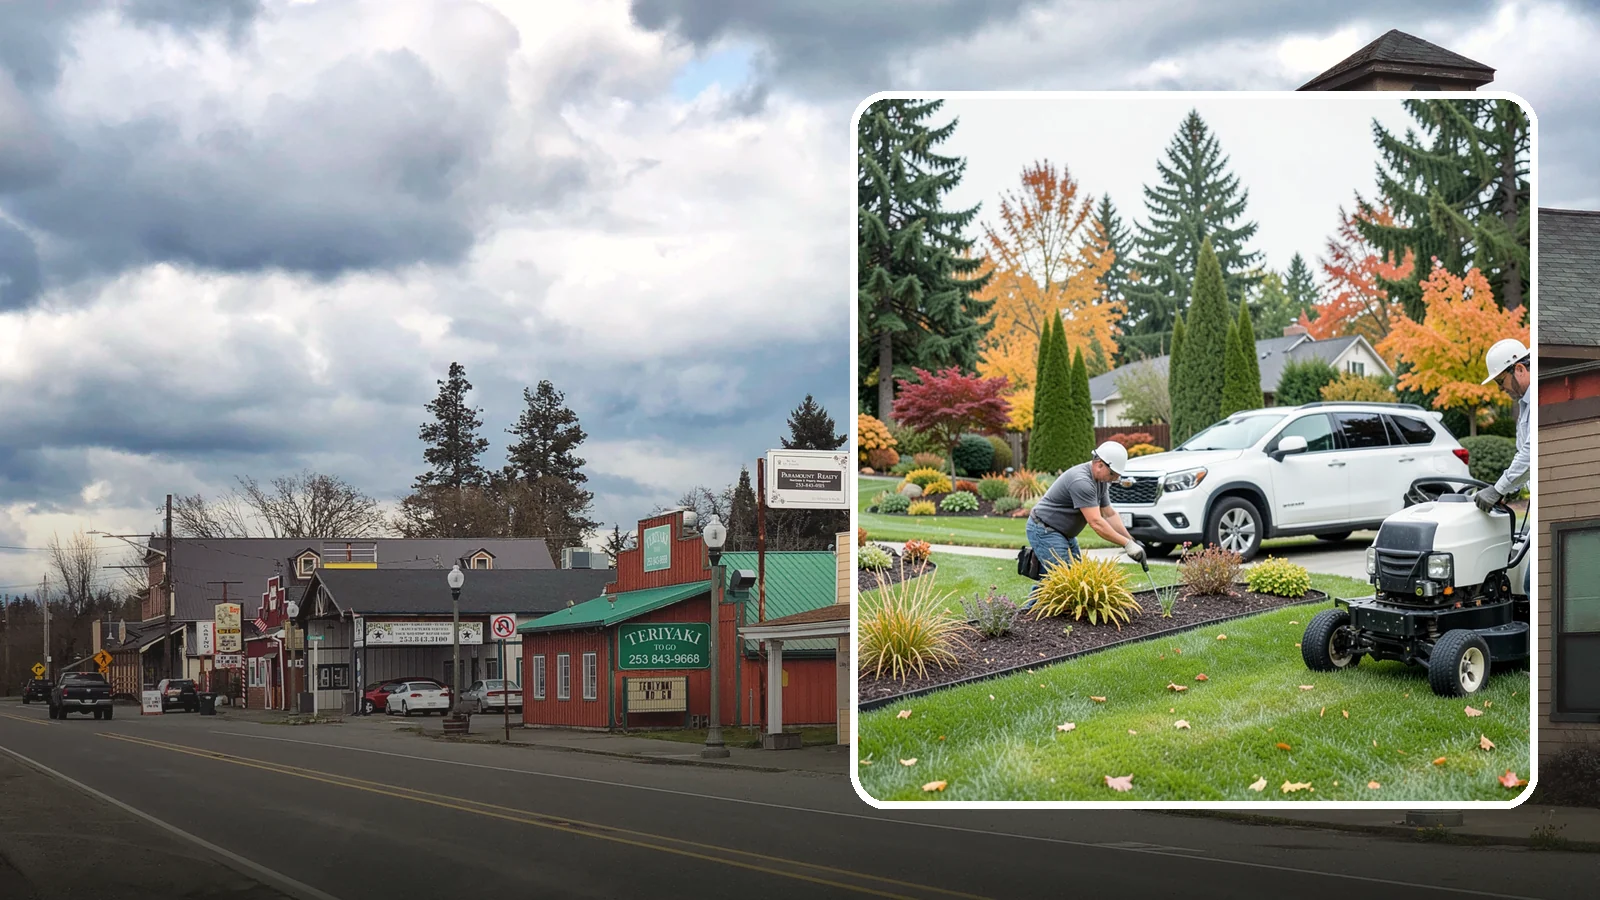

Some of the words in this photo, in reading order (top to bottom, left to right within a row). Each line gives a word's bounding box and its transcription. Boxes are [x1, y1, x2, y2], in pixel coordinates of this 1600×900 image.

[625, 627, 702, 646] TERIYAKI
[629, 654, 648, 665] 253
[652, 654, 700, 664] 843-9668
